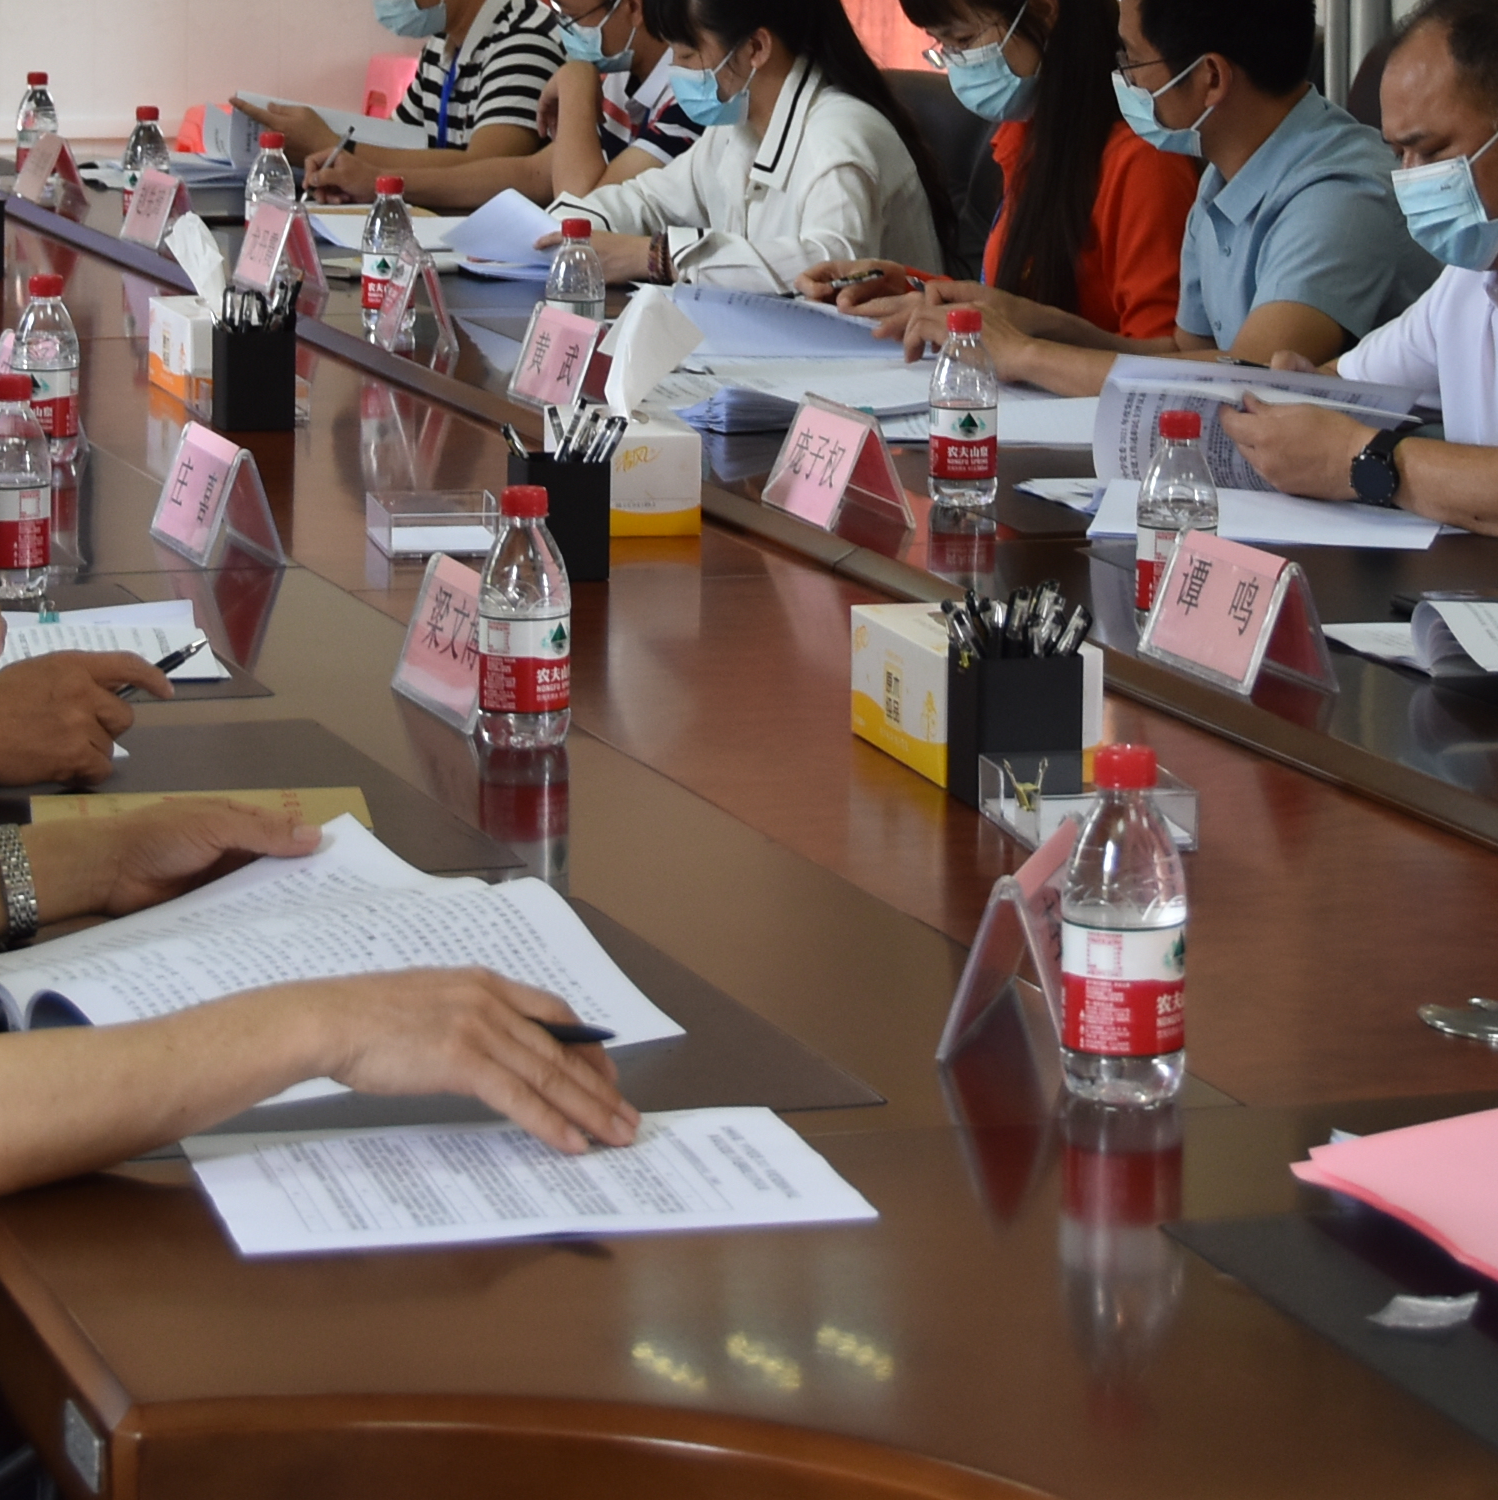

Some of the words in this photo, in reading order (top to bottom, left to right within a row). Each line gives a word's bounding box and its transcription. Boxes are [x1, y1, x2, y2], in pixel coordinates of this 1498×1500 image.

[788, 427, 846, 489] 庞子权
[947, 445, 989, 458] 农夫山泉
